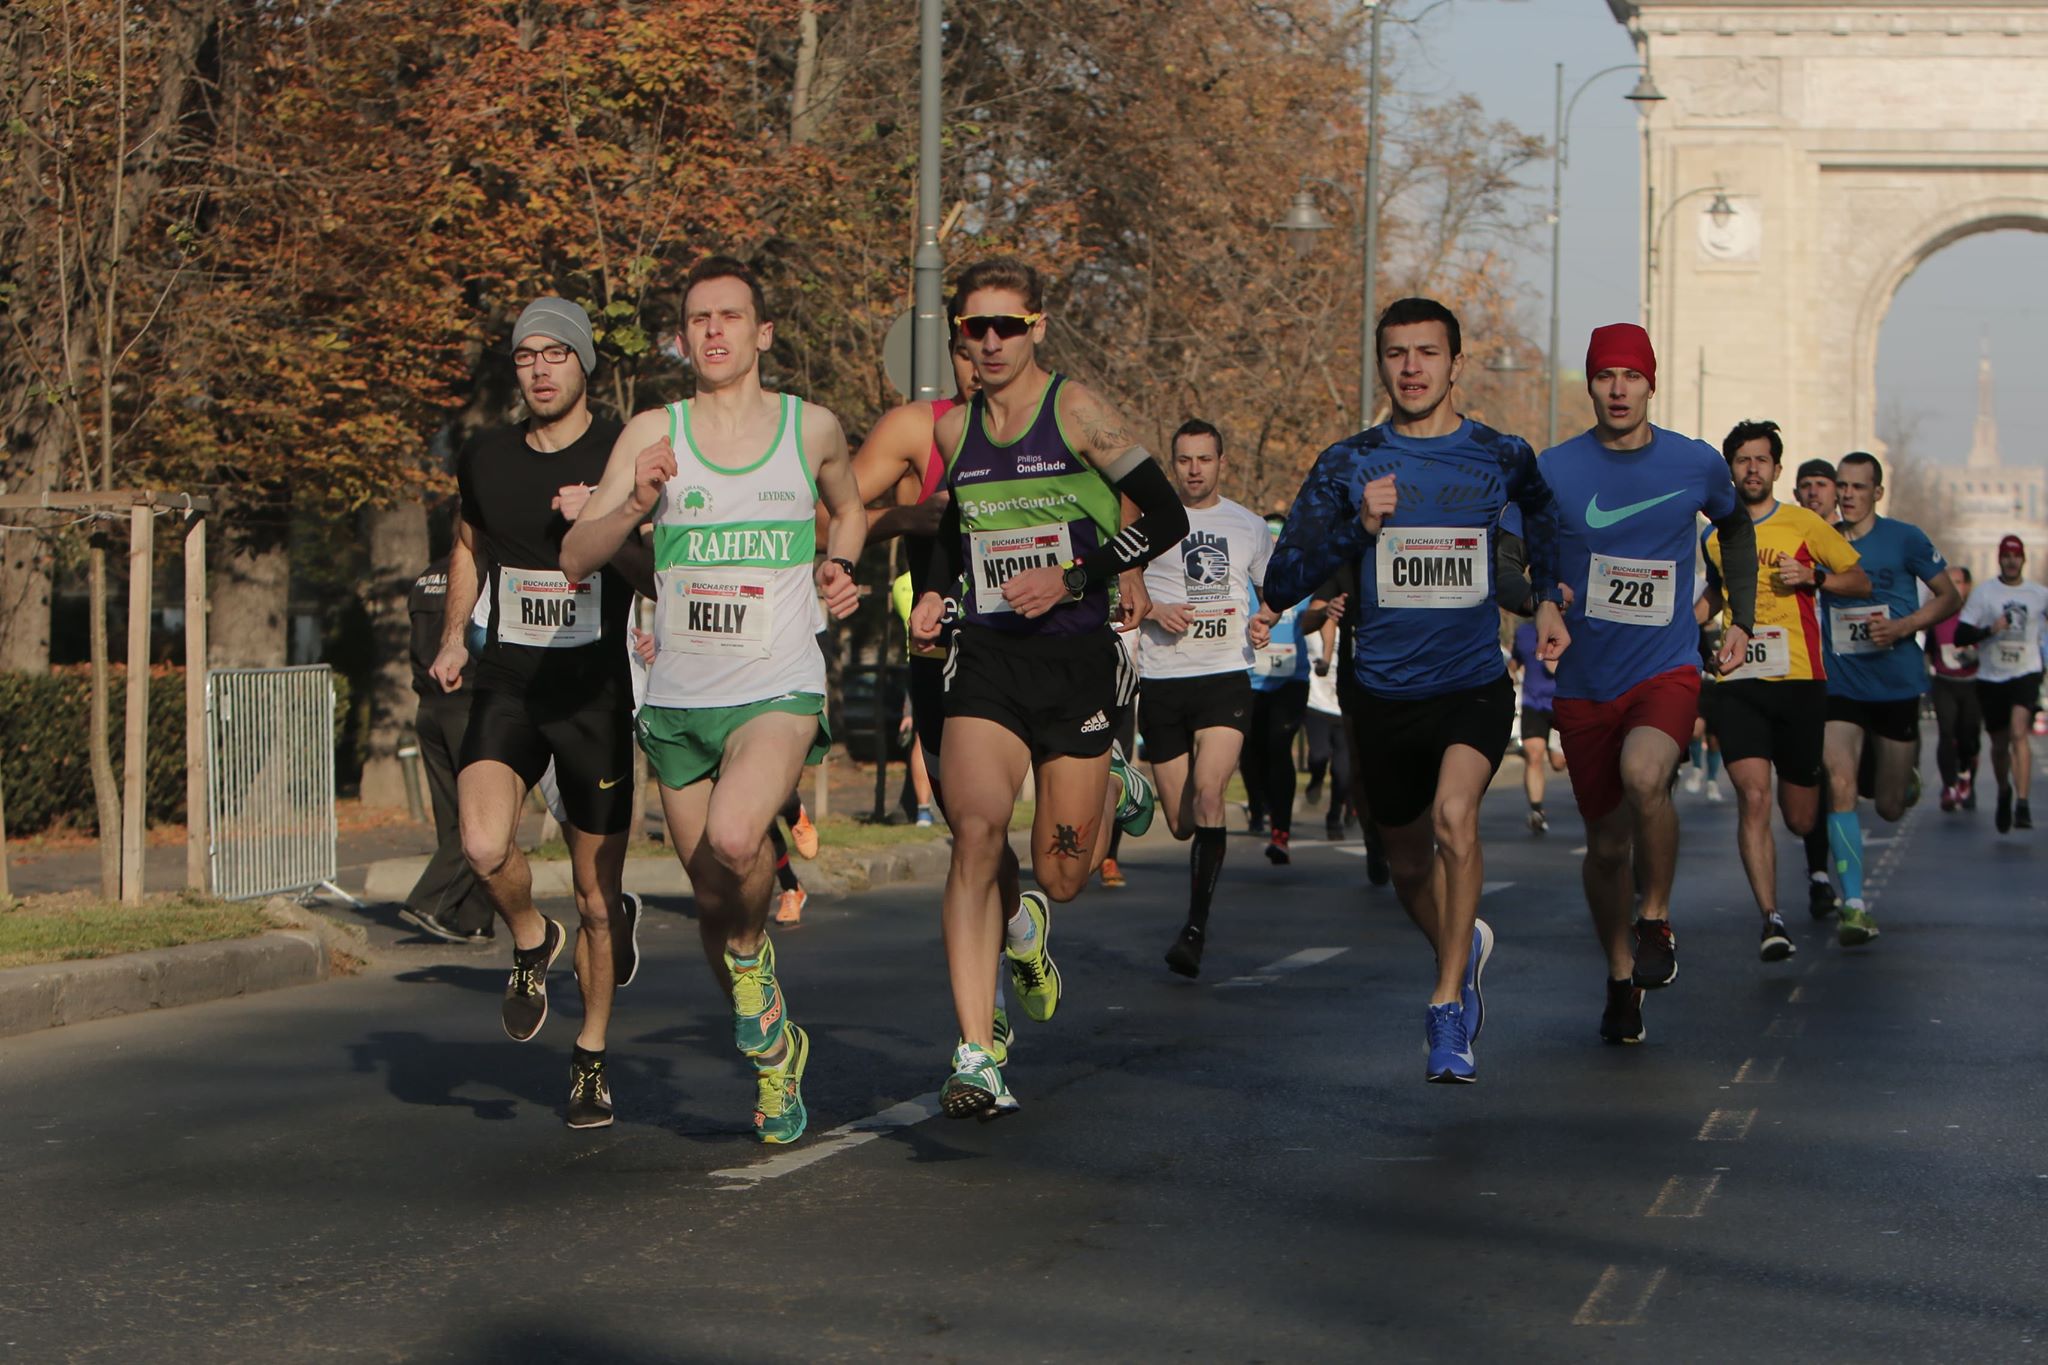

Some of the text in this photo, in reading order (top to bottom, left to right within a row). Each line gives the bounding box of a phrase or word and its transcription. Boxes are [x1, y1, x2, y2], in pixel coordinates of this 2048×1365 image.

[1017, 455, 1042, 464] Philips
[963, 468, 992, 479] GHOST
[1017, 461, 1066, 474] OneBlade
[758, 491, 796, 502] LEYDENS
[979, 494, 1077, 515] SportGuru.ro
[687, 530, 795, 562] RAHENY
[991, 537, 1034, 547] BUCHAREST
[1392, 556, 1473, 587] COMAN
[1612, 565, 1652, 574] BUCHAREST
[522, 580, 568, 588] BUCHAREST
[691, 583, 739, 592] BUCHAREST
[1608, 578, 1655, 608] 228
[520, 596, 577, 627] RANC
[688, 600, 747, 634] KELLY
[1193, 618, 1228, 639] 256
[1270, 655, 1282, 668] 15
[1080, 721, 1110, 733] adidas
